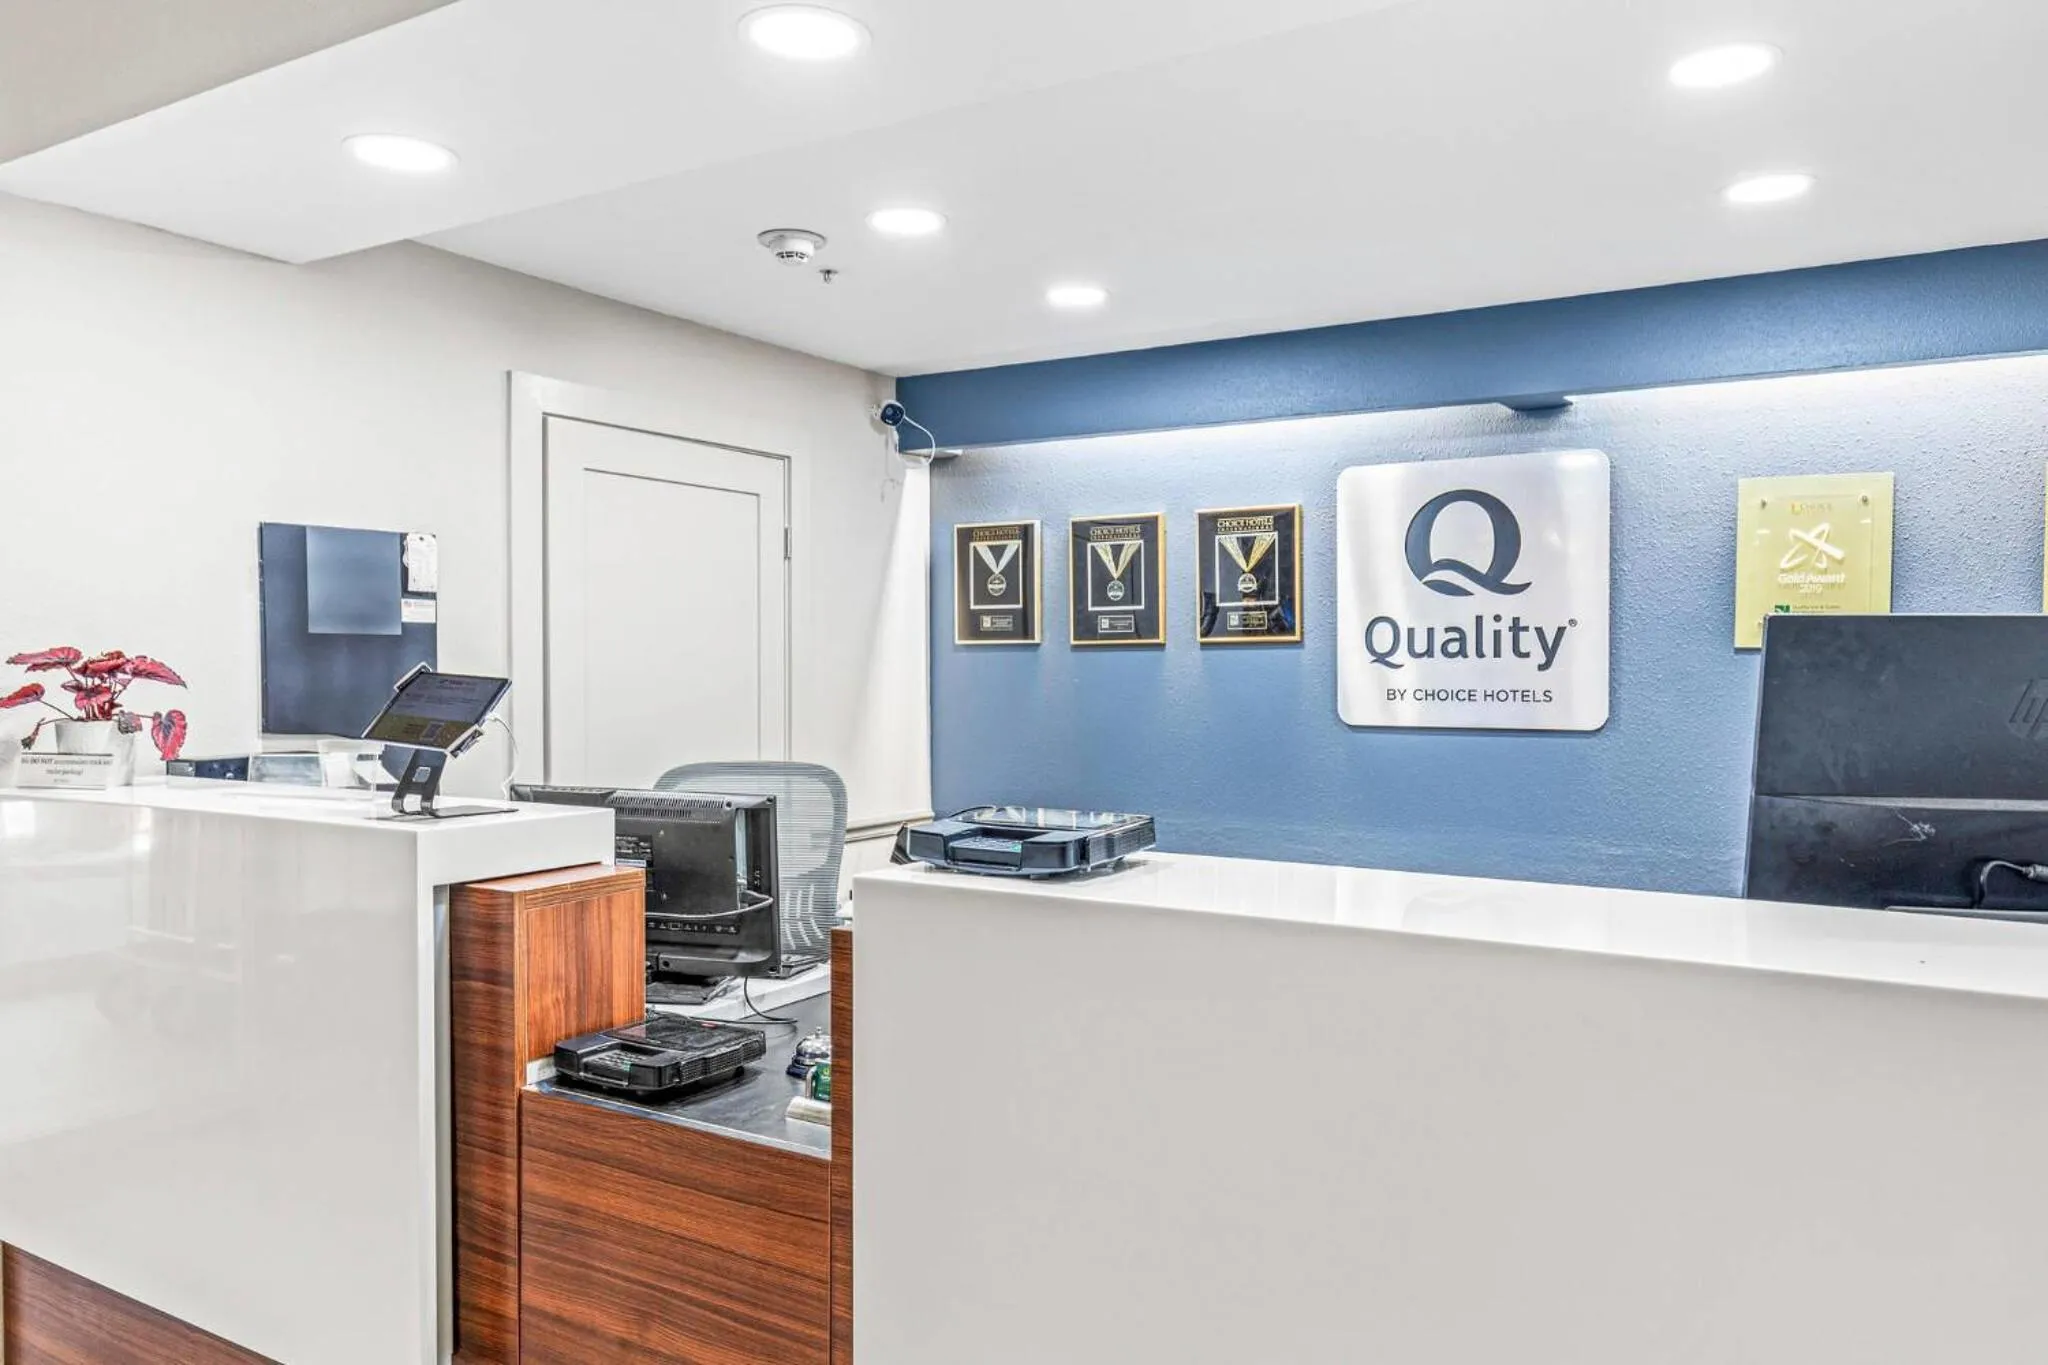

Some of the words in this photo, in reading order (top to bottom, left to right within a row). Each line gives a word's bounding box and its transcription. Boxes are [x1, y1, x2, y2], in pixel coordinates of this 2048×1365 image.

[1404, 488, 1533, 597] Q
[1777, 572, 1805, 585] Gold
[1805, 571, 1846, 584] Award
[1386, 688, 1408, 701] BY
[1413, 688, 1478, 702] CHOICE
[1483, 689, 1553, 703] HOTELS
